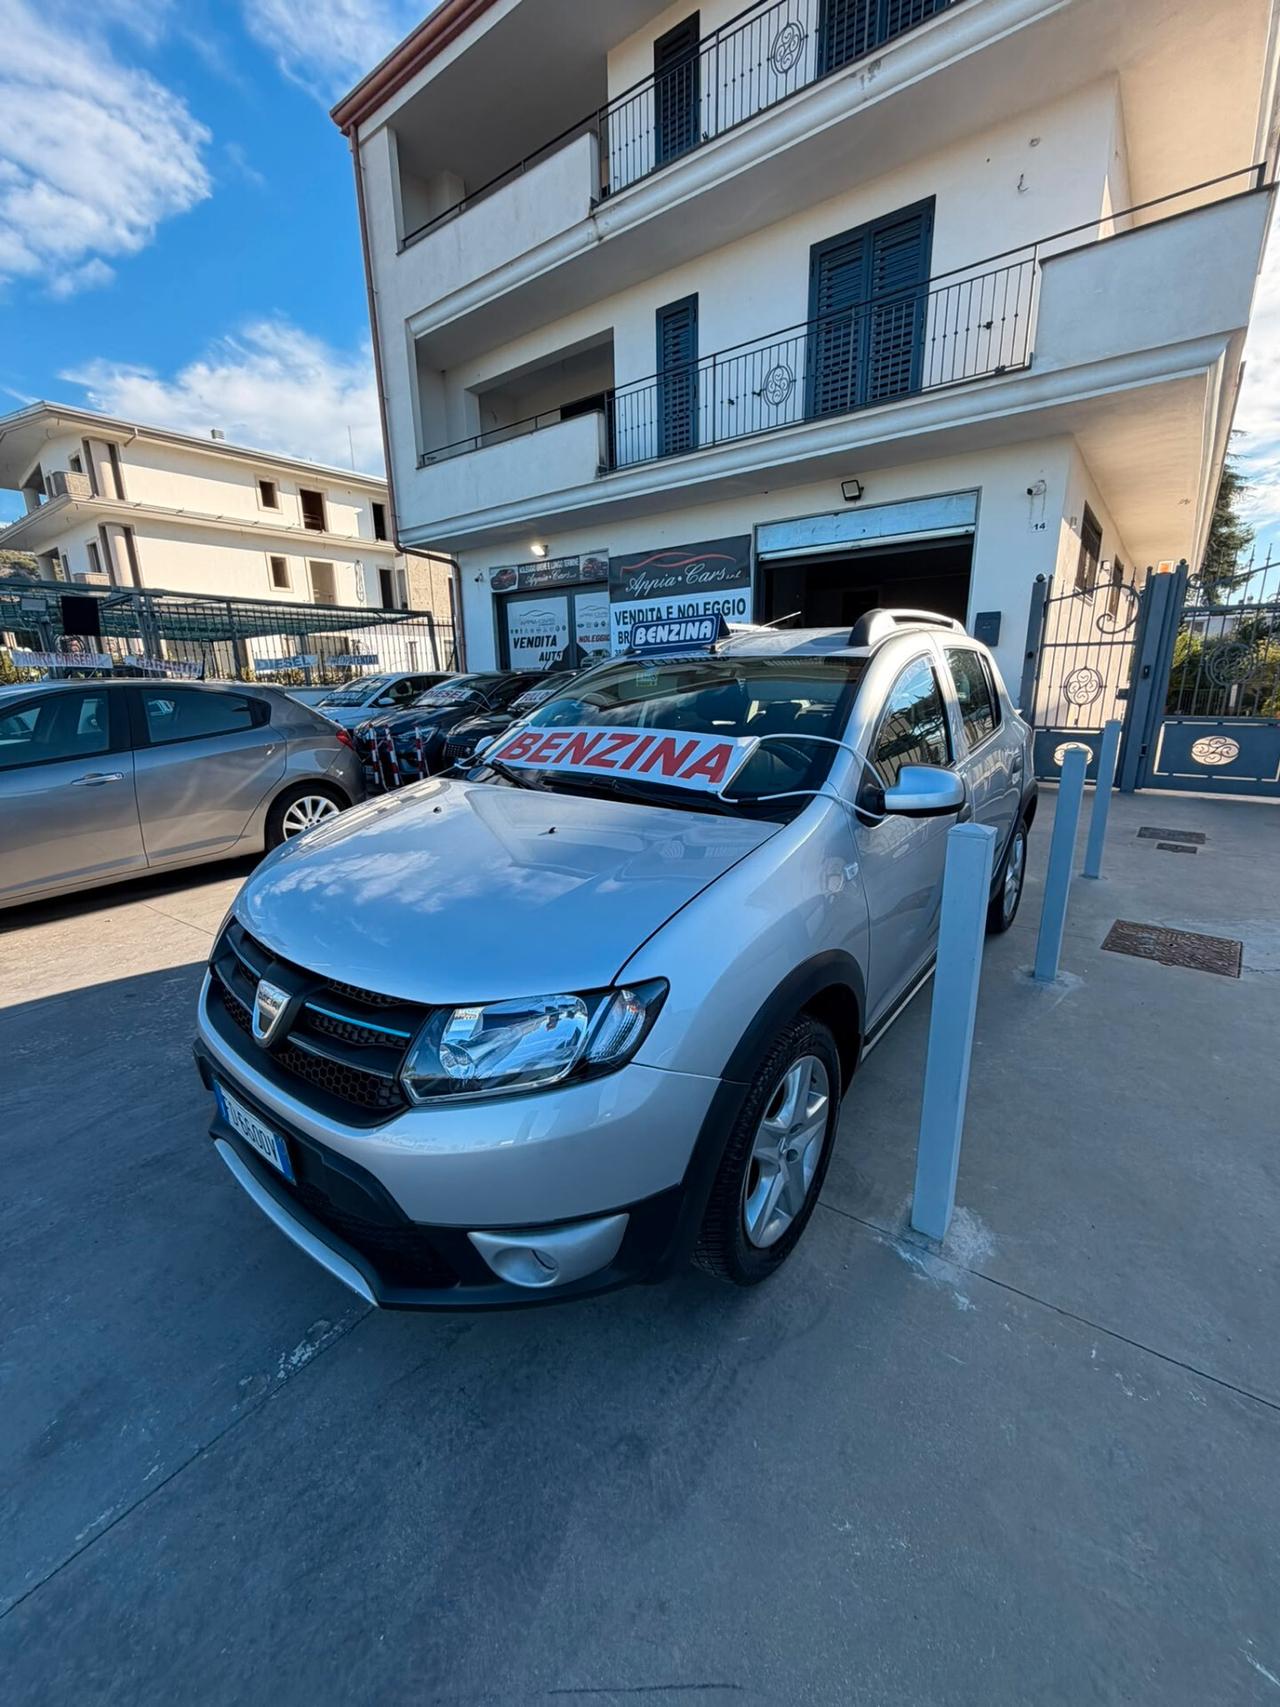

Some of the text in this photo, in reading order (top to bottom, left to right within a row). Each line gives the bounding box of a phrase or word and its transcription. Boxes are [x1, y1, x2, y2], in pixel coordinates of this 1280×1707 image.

[1035, 522, 1046, 531] 14
[625, 571, 677, 597] Appia
[684, 563, 727, 584] Cars
[614, 607, 662, 626] VENDITA
[677, 598, 747, 619] NOLEGGIO
[513, 634, 557, 649] VENDITA
[634, 620, 713, 645] BENZINA
[423, 689, 468, 700] DIESEL
[495, 731, 735, 785] BENZINA
